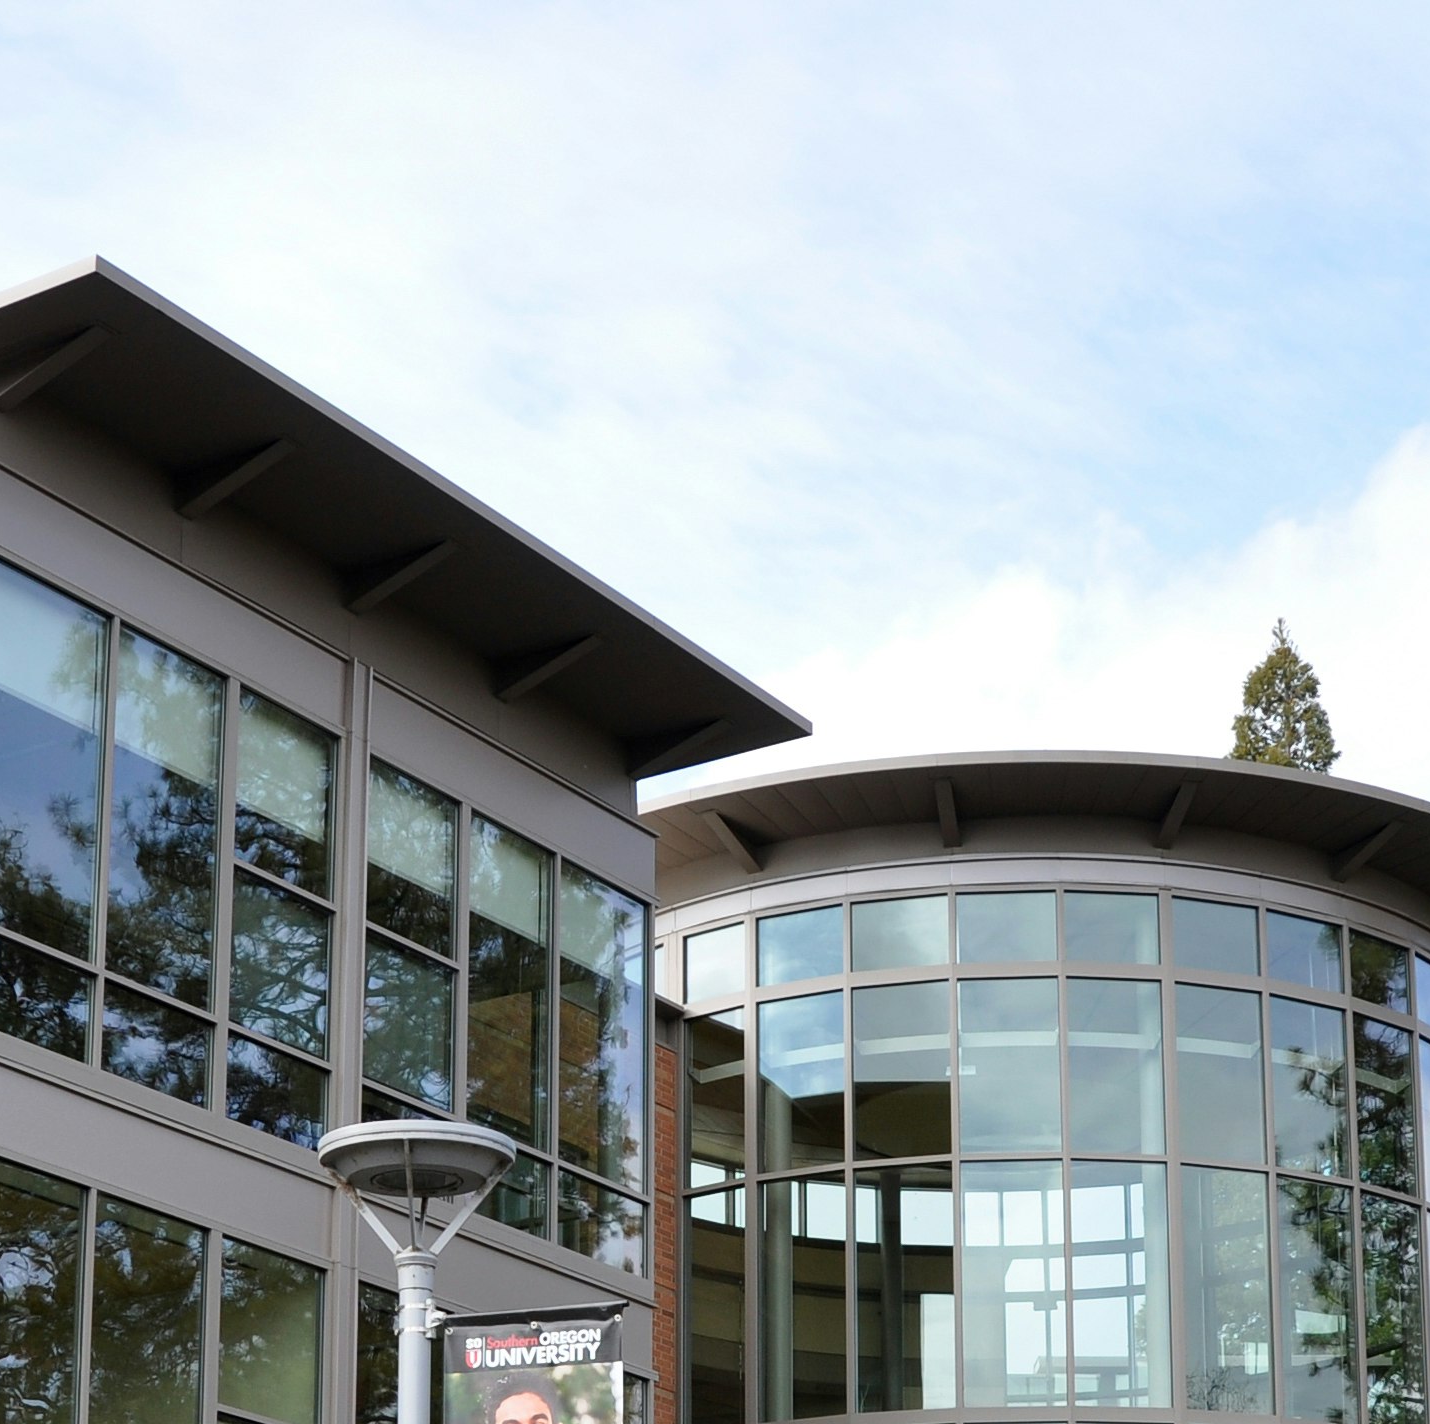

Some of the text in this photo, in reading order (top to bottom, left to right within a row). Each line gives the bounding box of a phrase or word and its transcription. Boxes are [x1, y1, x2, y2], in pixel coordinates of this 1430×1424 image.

[486, 1327, 602, 1349] Southern OREGON
[485, 1341, 602, 1368] UNIVERSITY
